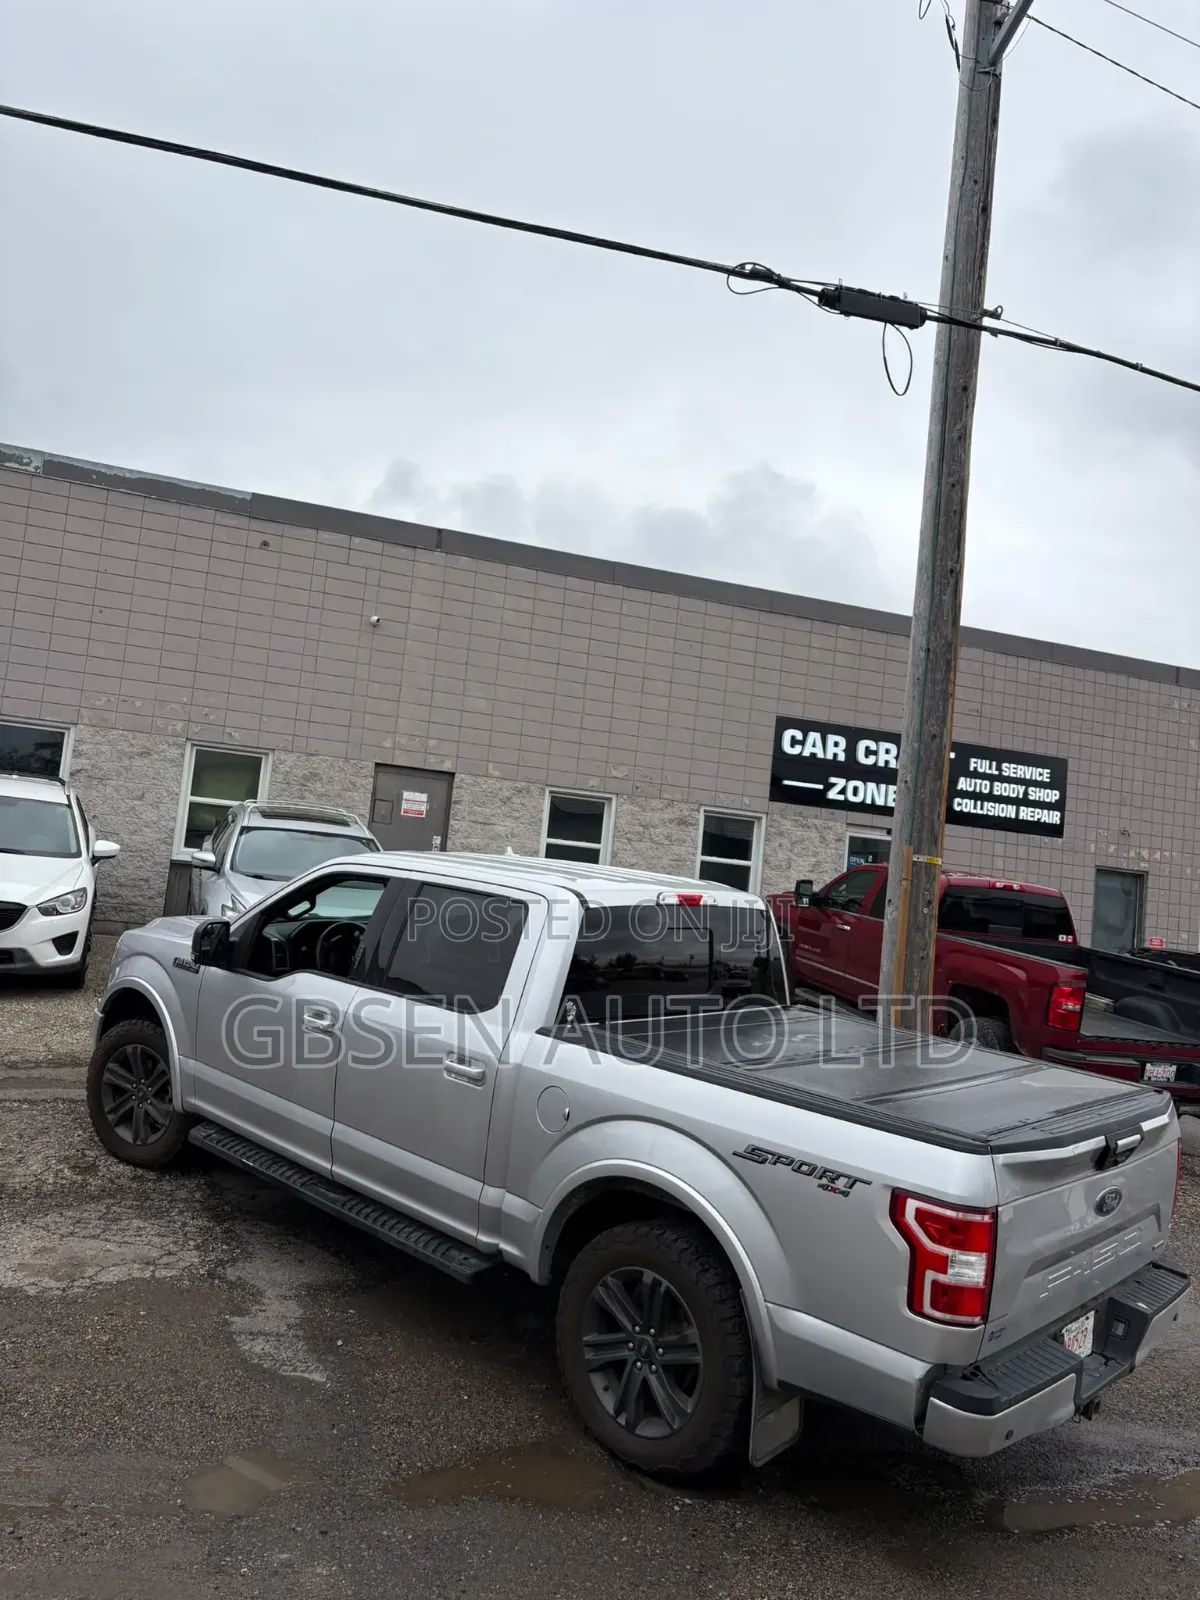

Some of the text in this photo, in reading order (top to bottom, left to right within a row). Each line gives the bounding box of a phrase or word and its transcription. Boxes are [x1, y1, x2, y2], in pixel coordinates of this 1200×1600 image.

[781, 728, 846, 762] CAR
[969, 758, 1051, 782] FULL SERVICE
[956, 777, 1060, 803] AUTO BODY SHOP
[953, 798, 1061, 825] COLLISION REPAIR
[849, 856, 865, 865] OPEN
[731, 1143, 873, 1190] SPORT
